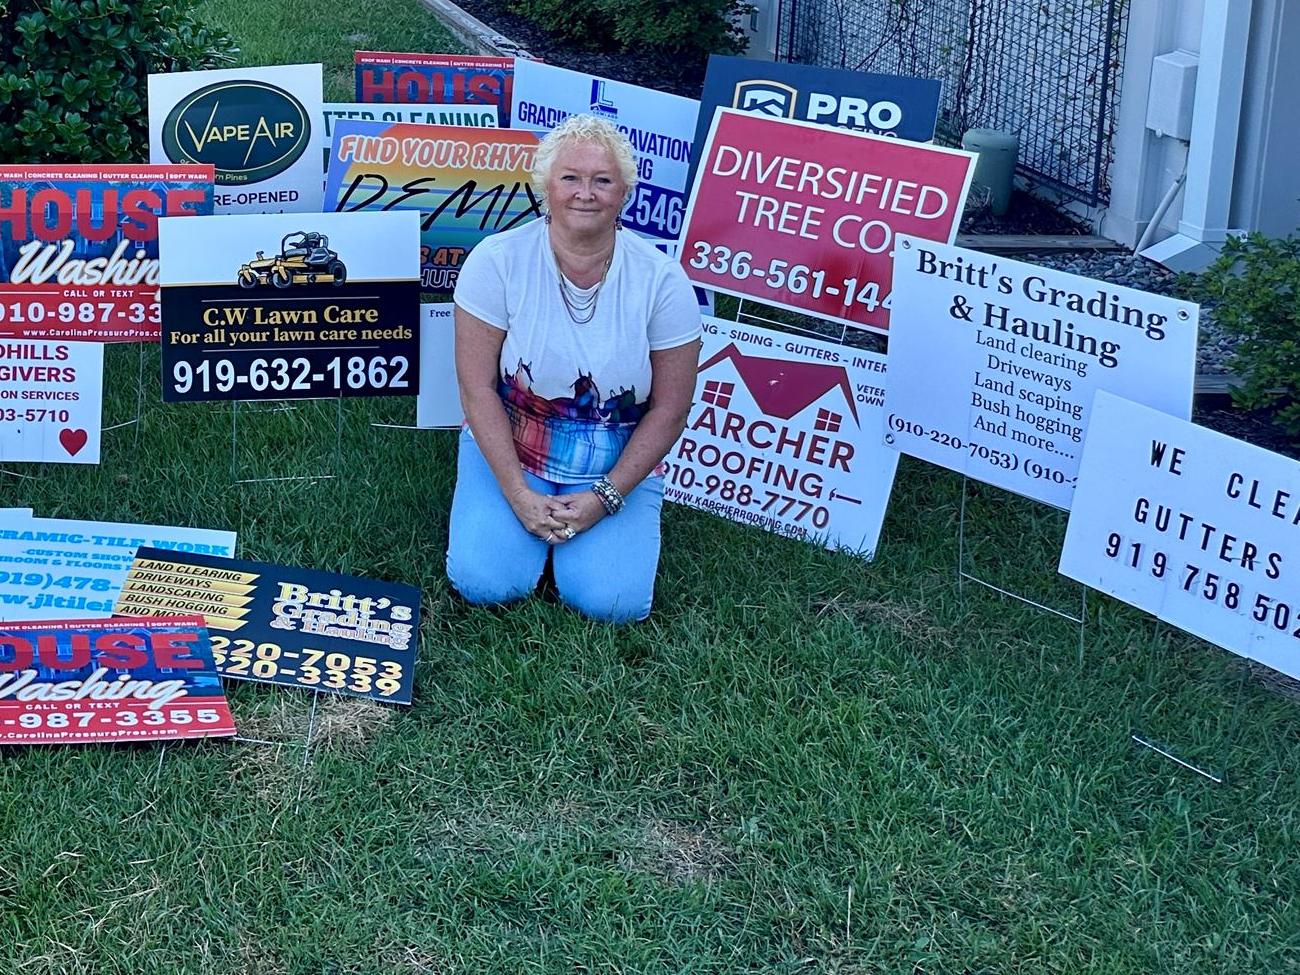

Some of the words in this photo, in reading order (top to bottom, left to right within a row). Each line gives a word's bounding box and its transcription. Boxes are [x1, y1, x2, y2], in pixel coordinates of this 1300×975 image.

[362, 69, 515, 108] HOUS
[806, 92, 902, 130] PRO
[337, 135, 400, 165] FIND
[402, 137, 471, 169] YOUR
[225, 174, 248, 182] Pines
[712, 145, 949, 220] DIVERSIFIED
[735, 190, 825, 240] TREE
[916, 248, 1014, 295] Britt's
[1022, 276, 1168, 341] Grading
[202, 307, 249, 326] C.W
[254, 306, 318, 325] Lawn
[323, 305, 379, 324] Care
[429, 309, 451, 318] Free
[170, 331, 201, 345] For
[203, 329, 226, 344] all
[229, 330, 272, 347] your
[274, 327, 316, 342] lawn
[319, 328, 358, 341] care
[361, 325, 413, 340] needs
[729, 329, 773, 348] SIDING
[784, 342, 840, 363] GUTTERS
[983, 301, 1121, 368] Hauling
[975, 329, 1016, 354] Land
[1020, 342, 1089, 378] clearing
[173, 355, 410, 394] 919-632-1862
[986, 354, 1073, 392] Driveways
[21, 390, 80, 401] SERVICES
[974, 371, 1015, 397] Land
[1018, 385, 1084, 420] scaping
[971, 391, 1011, 416] Bush
[1015, 403, 1083, 442] hogging
[973, 414, 1008, 437] And
[678, 437, 824, 499] ROOFING
[1150, 439, 1186, 476] WE
[152, 540, 229, 556] WORK
[1133, 497, 1283, 580] GUTTERS
[63, 558, 122, 571] FLOORS
[133, 571, 213, 589] DRIVEWAYS
[177, 565, 243, 582] CLEARING
[1106, 532, 1167, 578] 919
[1183, 564, 1241, 610] 758
[129, 582, 225, 603] LANDSCAPING
[165, 599, 229, 616] HOGGING
[119, 605, 154, 617] AND
[298, 620, 410, 651] Hauling
